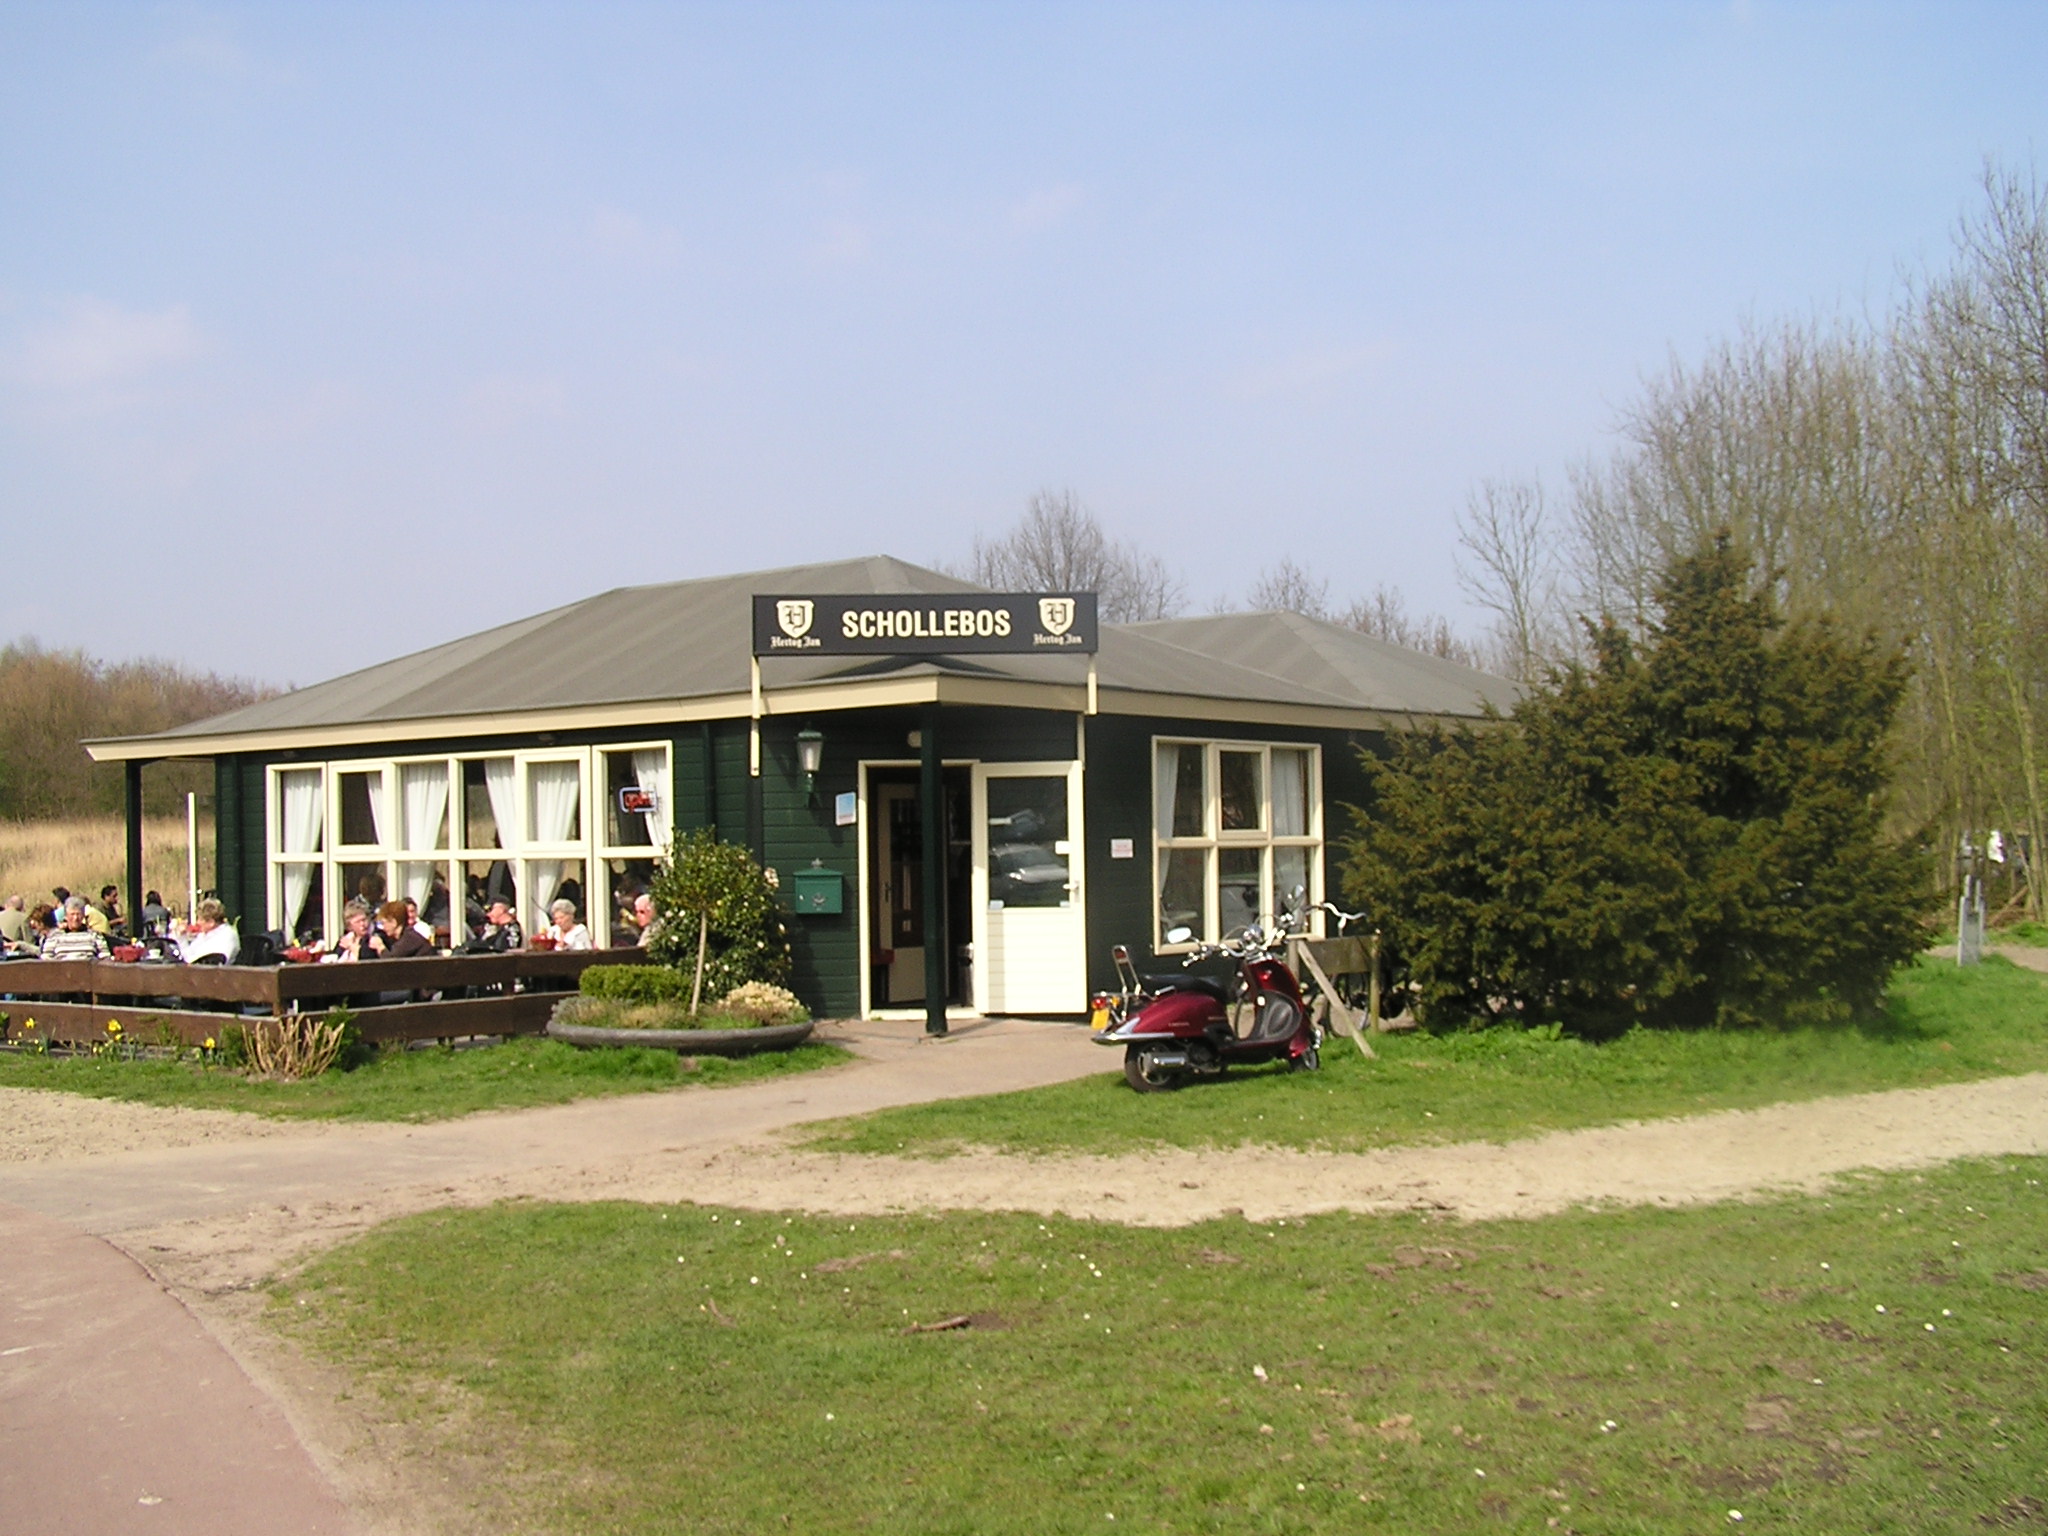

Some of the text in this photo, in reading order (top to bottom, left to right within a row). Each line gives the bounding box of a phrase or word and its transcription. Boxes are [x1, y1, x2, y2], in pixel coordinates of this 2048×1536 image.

[842, 609, 1011, 638] SCHOLLEBOS
[770, 635, 821, 649] Hertog Jan
[1033, 632, 1083, 646] Hertog Jan
